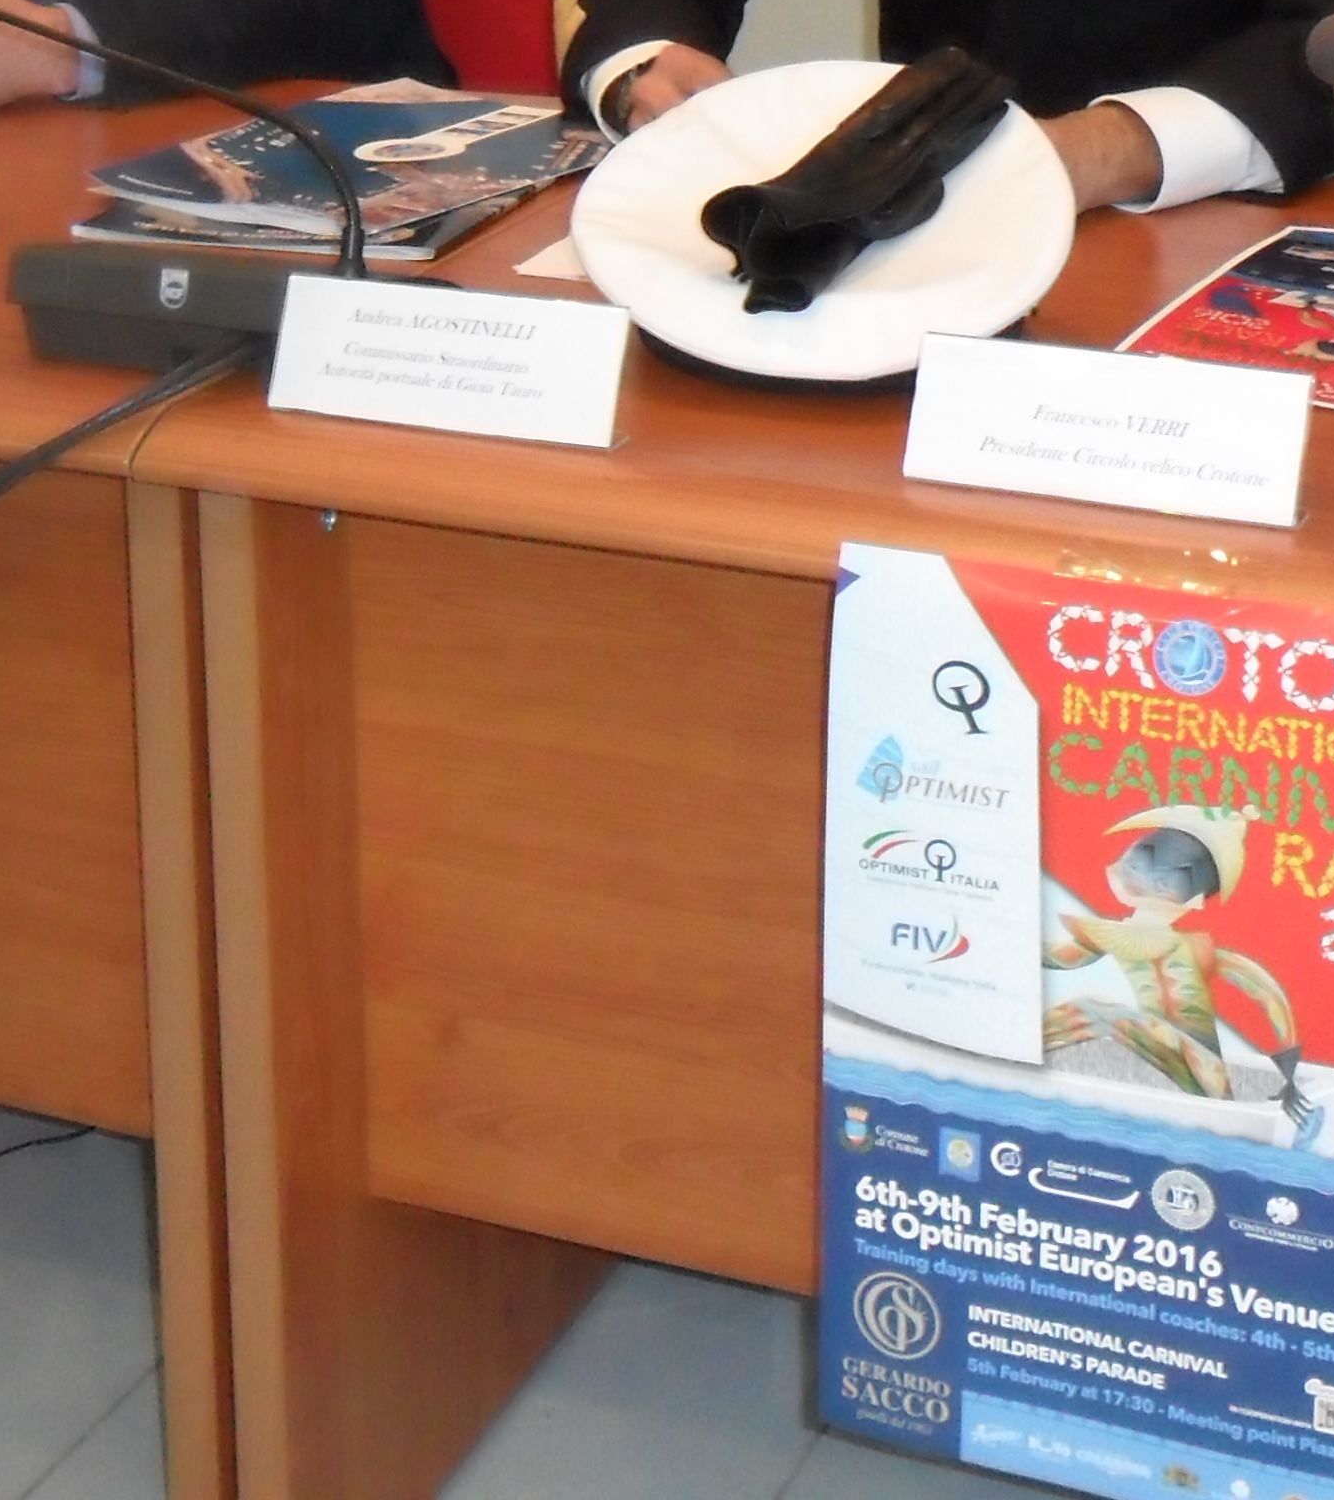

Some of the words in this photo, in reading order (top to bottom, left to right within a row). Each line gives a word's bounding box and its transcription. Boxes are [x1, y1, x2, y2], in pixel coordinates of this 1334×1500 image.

[348, 308, 403, 327] Andrea
[407, 314, 537, 342] AGOSTINELLI
[343, 341, 435, 365] Commissario
[437, 351, 529, 376] Straordinario
[376, 371, 435, 391] portuale
[438, 373, 453, 390] di
[501, 382, 542, 400] Tauro
[1033, 403, 1118, 430] Francesco
[1125, 415, 1190, 439] VERRI
[980, 436, 1069, 462] Presidente
[1072, 447, 1136, 471] Circolo
[1141, 456, 1192, 479] velico
[1196, 463, 1270, 489] Crotone
[873, 762, 1010, 809] OPTIMIST
[859, 858, 929, 880] OPTIMIST
[950, 874, 999, 891] ITALIA
[890, 921, 947, 954] FIV
[855, 1175, 972, 1225] 6th-9th
[980, 1202, 1126, 1262] February
[1133, 1234, 1223, 1279] 2016
[855, 1207, 886, 1233] at
[892, 1211, 1033, 1267] Optimist
[1040, 1243, 1224, 1308] European's
[854, 1237, 929, 1274] Training
[933, 1257, 978, 1284] days
[983, 1266, 1026, 1293] with
[1030, 1276, 1155, 1321] International
[1160, 1308, 1247, 1344] coaches:
[1250, 1329, 1286, 1352] 4th
[968, 1304, 1125, 1354] INTERNATIONAL
[1128, 1339, 1229, 1379] CARNIVAL
[968, 1331, 1082, 1369] CHILDREN'S
[1085, 1356, 1166, 1391] PARADE
[841, 1376, 950, 1424] SACCO
[842, 1356, 951, 1399] GERARDO
[968, 1357, 996, 1378] 5th
[1000, 1365, 1077, 1398] February
[1080, 1385, 1098, 1400] at
[1102, 1389, 1154, 1415] 17:30
[1167, 1404, 1243, 1441] Meeting
[1246, 1425, 1296, 1450] point
